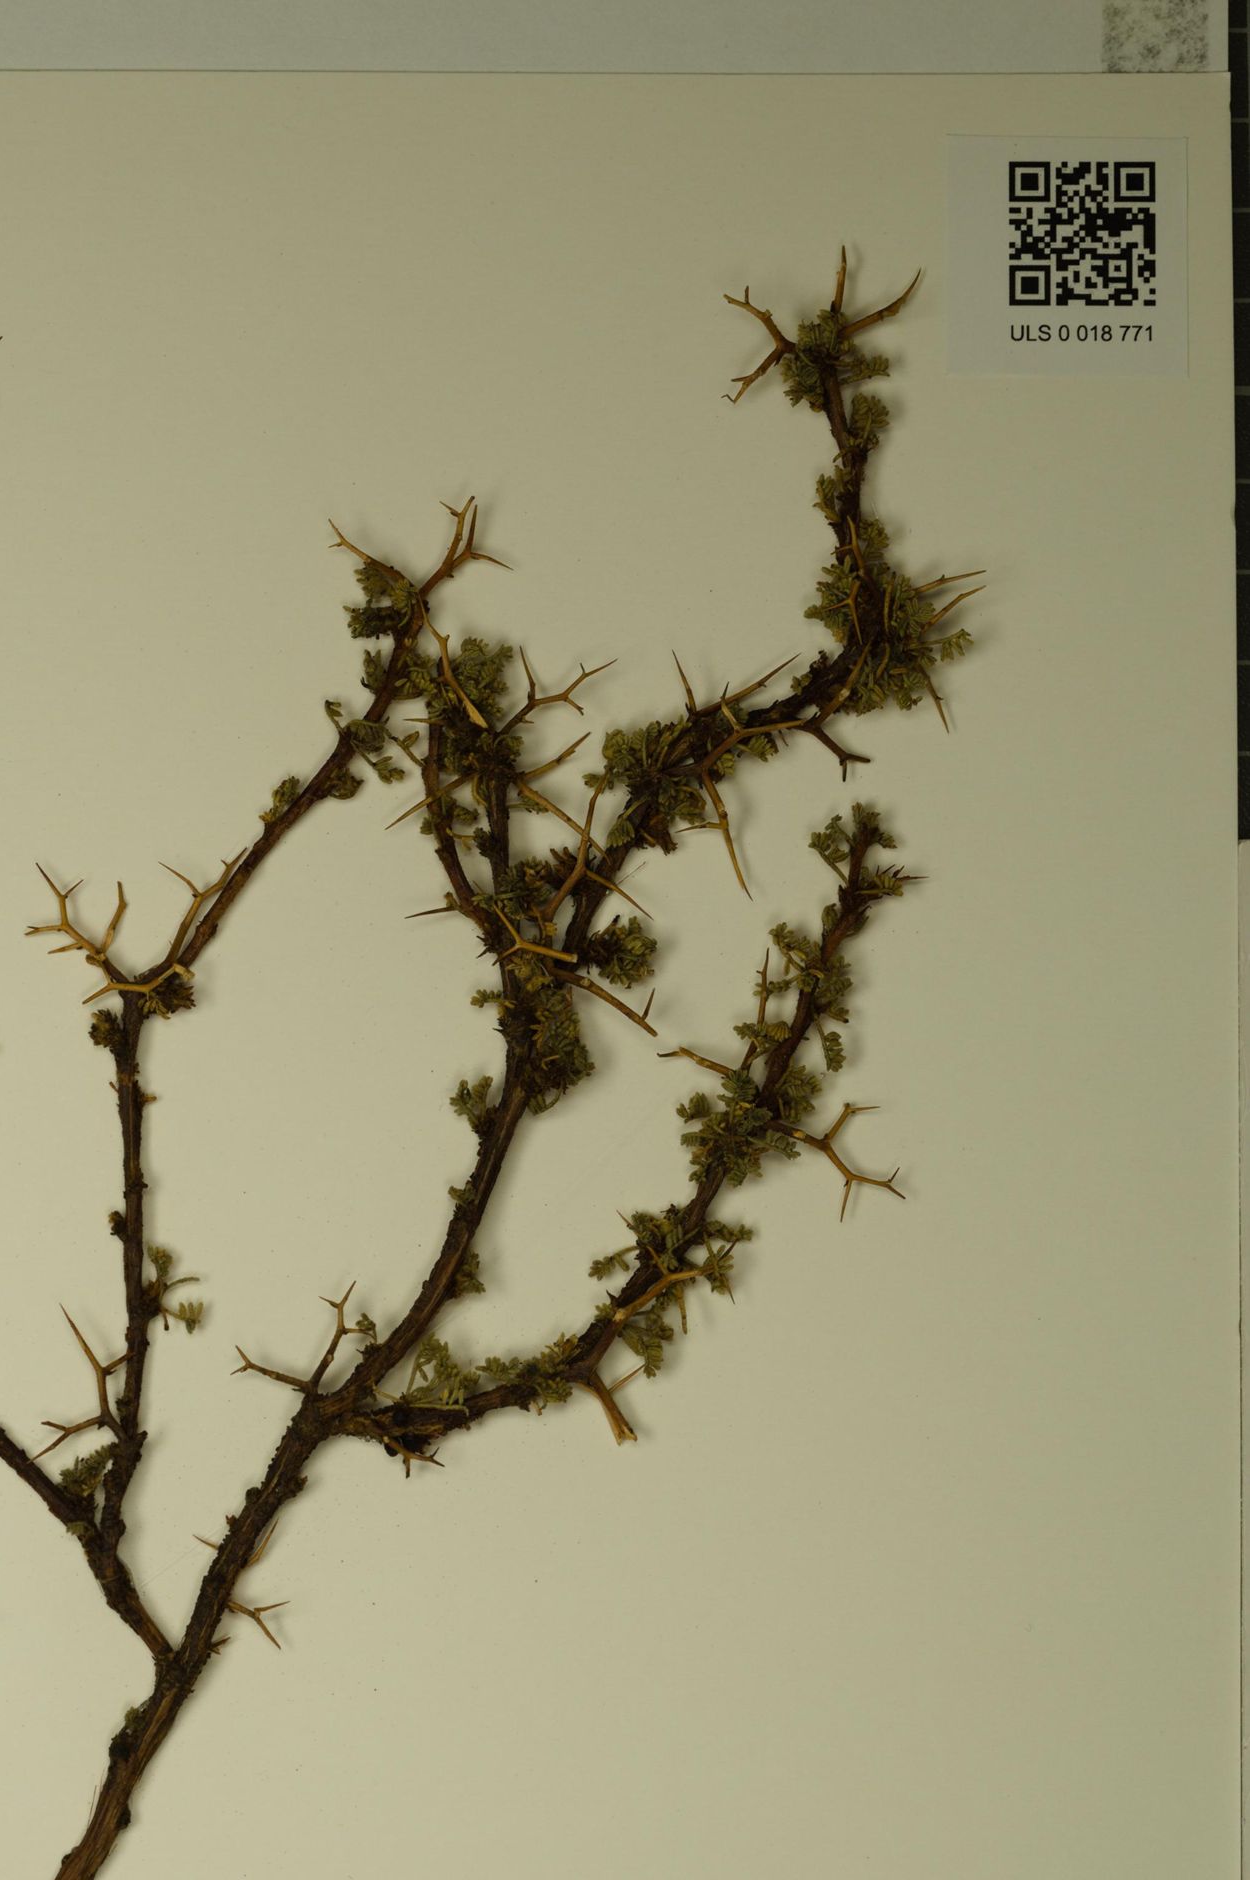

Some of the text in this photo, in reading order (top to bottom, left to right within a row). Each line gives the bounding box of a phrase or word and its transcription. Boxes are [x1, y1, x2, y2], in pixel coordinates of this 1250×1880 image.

[1010, 324, 1153, 342] ULS 0 018 771
